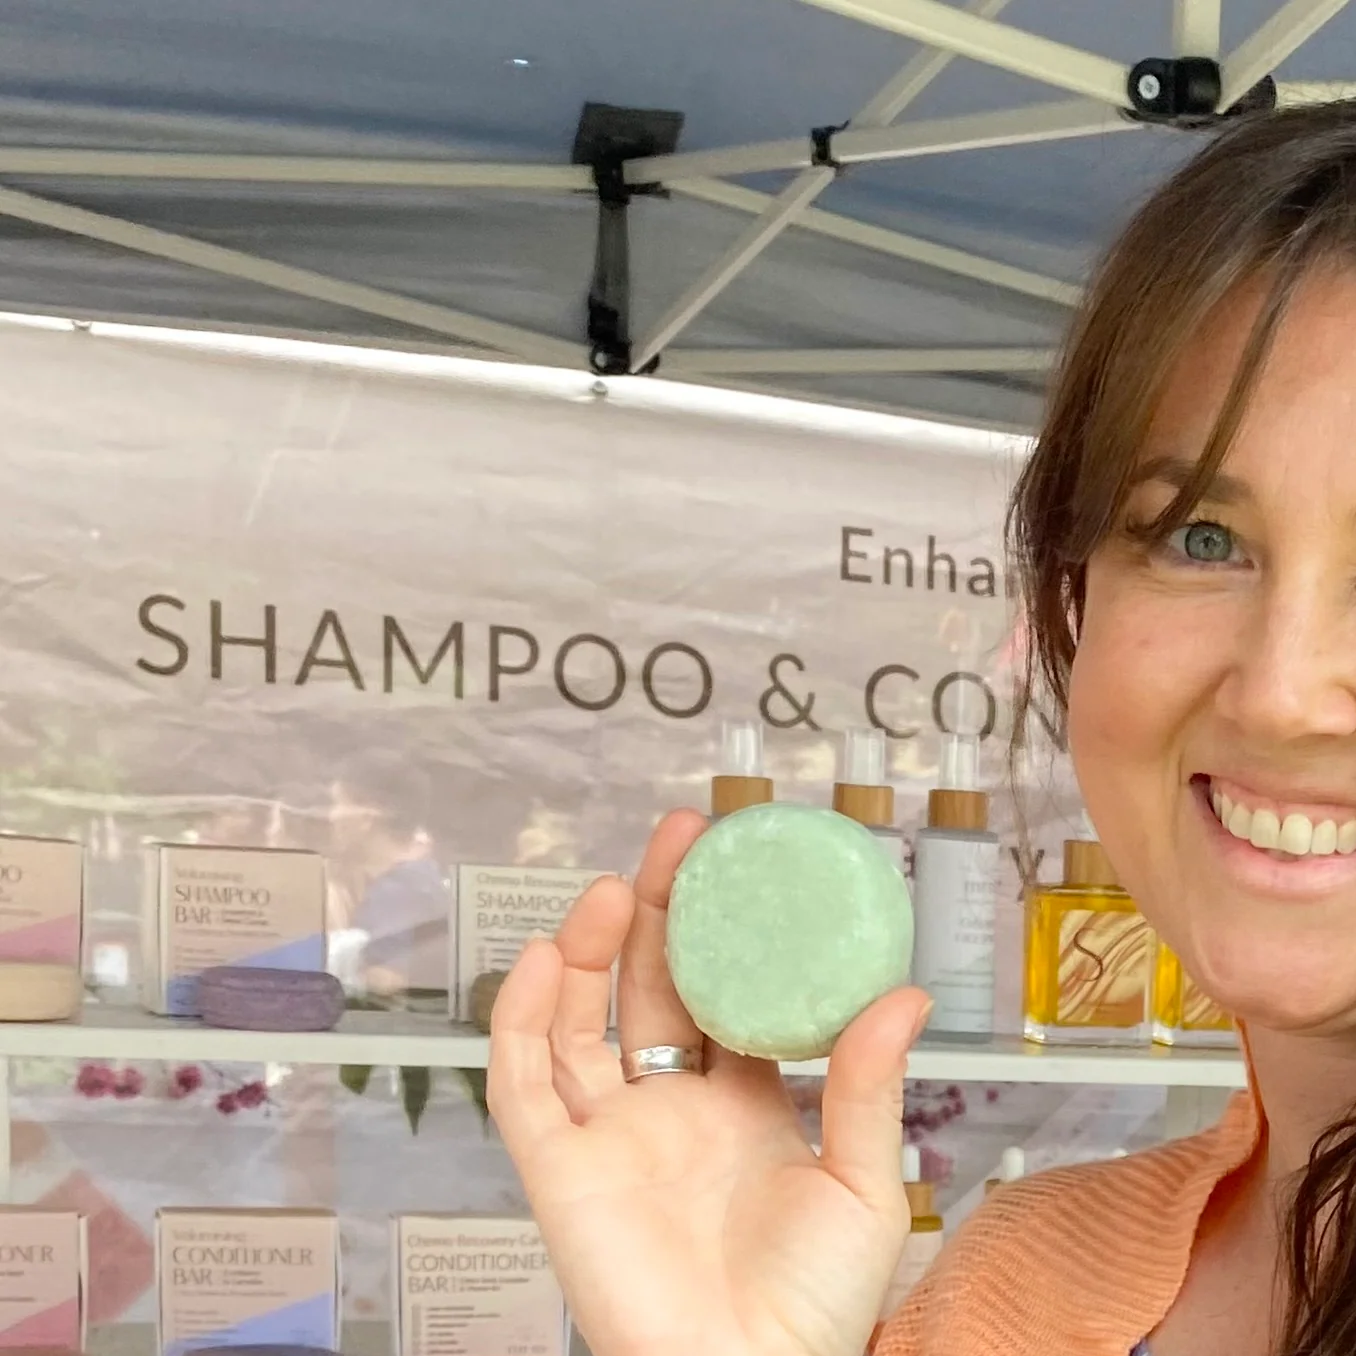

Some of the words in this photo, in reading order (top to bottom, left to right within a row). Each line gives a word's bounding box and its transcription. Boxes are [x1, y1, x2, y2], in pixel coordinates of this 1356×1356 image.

[136, 594, 713, 719] SHAMPOO
[759, 653, 822, 732] &
[174, 883, 271, 907] SHAMPOO
[174, 905, 212, 926] BAR
[172, 1245, 314, 1266] CONDITIONER
[172, 1267, 213, 1287] BAR
[407, 1275, 449, 1295] BAR
